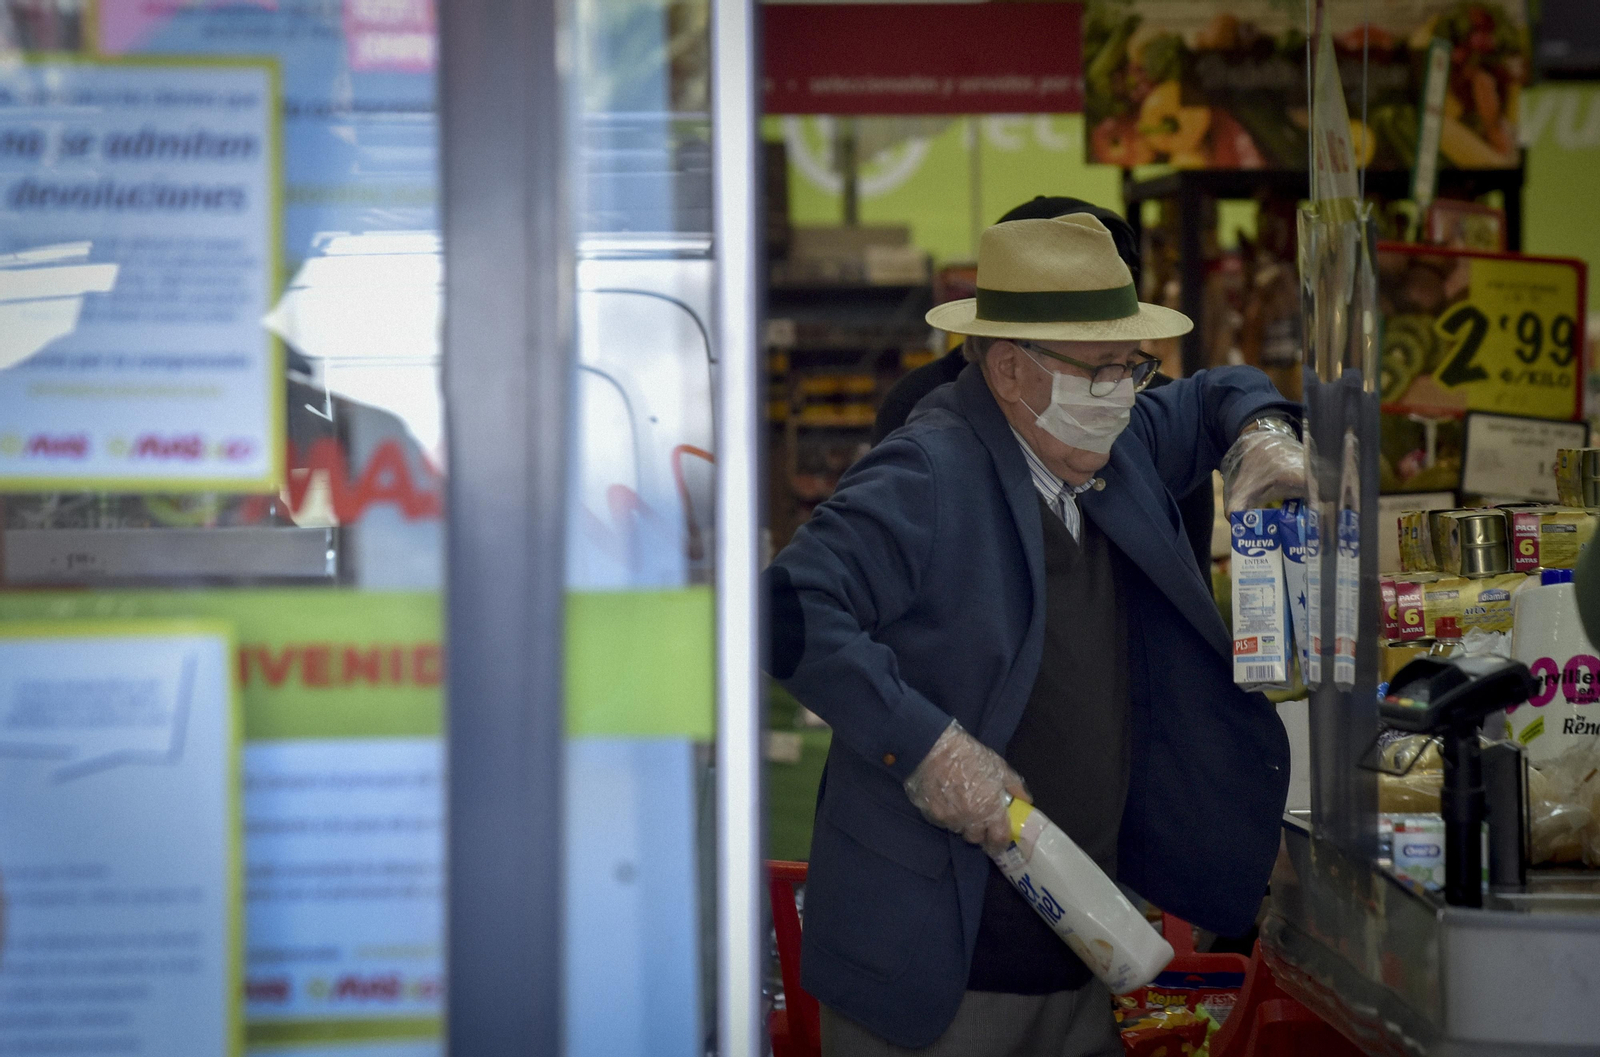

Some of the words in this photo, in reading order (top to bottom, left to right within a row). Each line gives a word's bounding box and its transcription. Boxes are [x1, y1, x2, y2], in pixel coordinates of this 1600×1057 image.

[1237, 538, 1275, 548] PULEVA
[1519, 539, 1535, 556] 6
[1481, 592, 1508, 601] diamir
[1404, 608, 1420, 625] 6
[1235, 640, 1248, 651] PLS
[1147, 990, 1188, 1007] KOJAK
